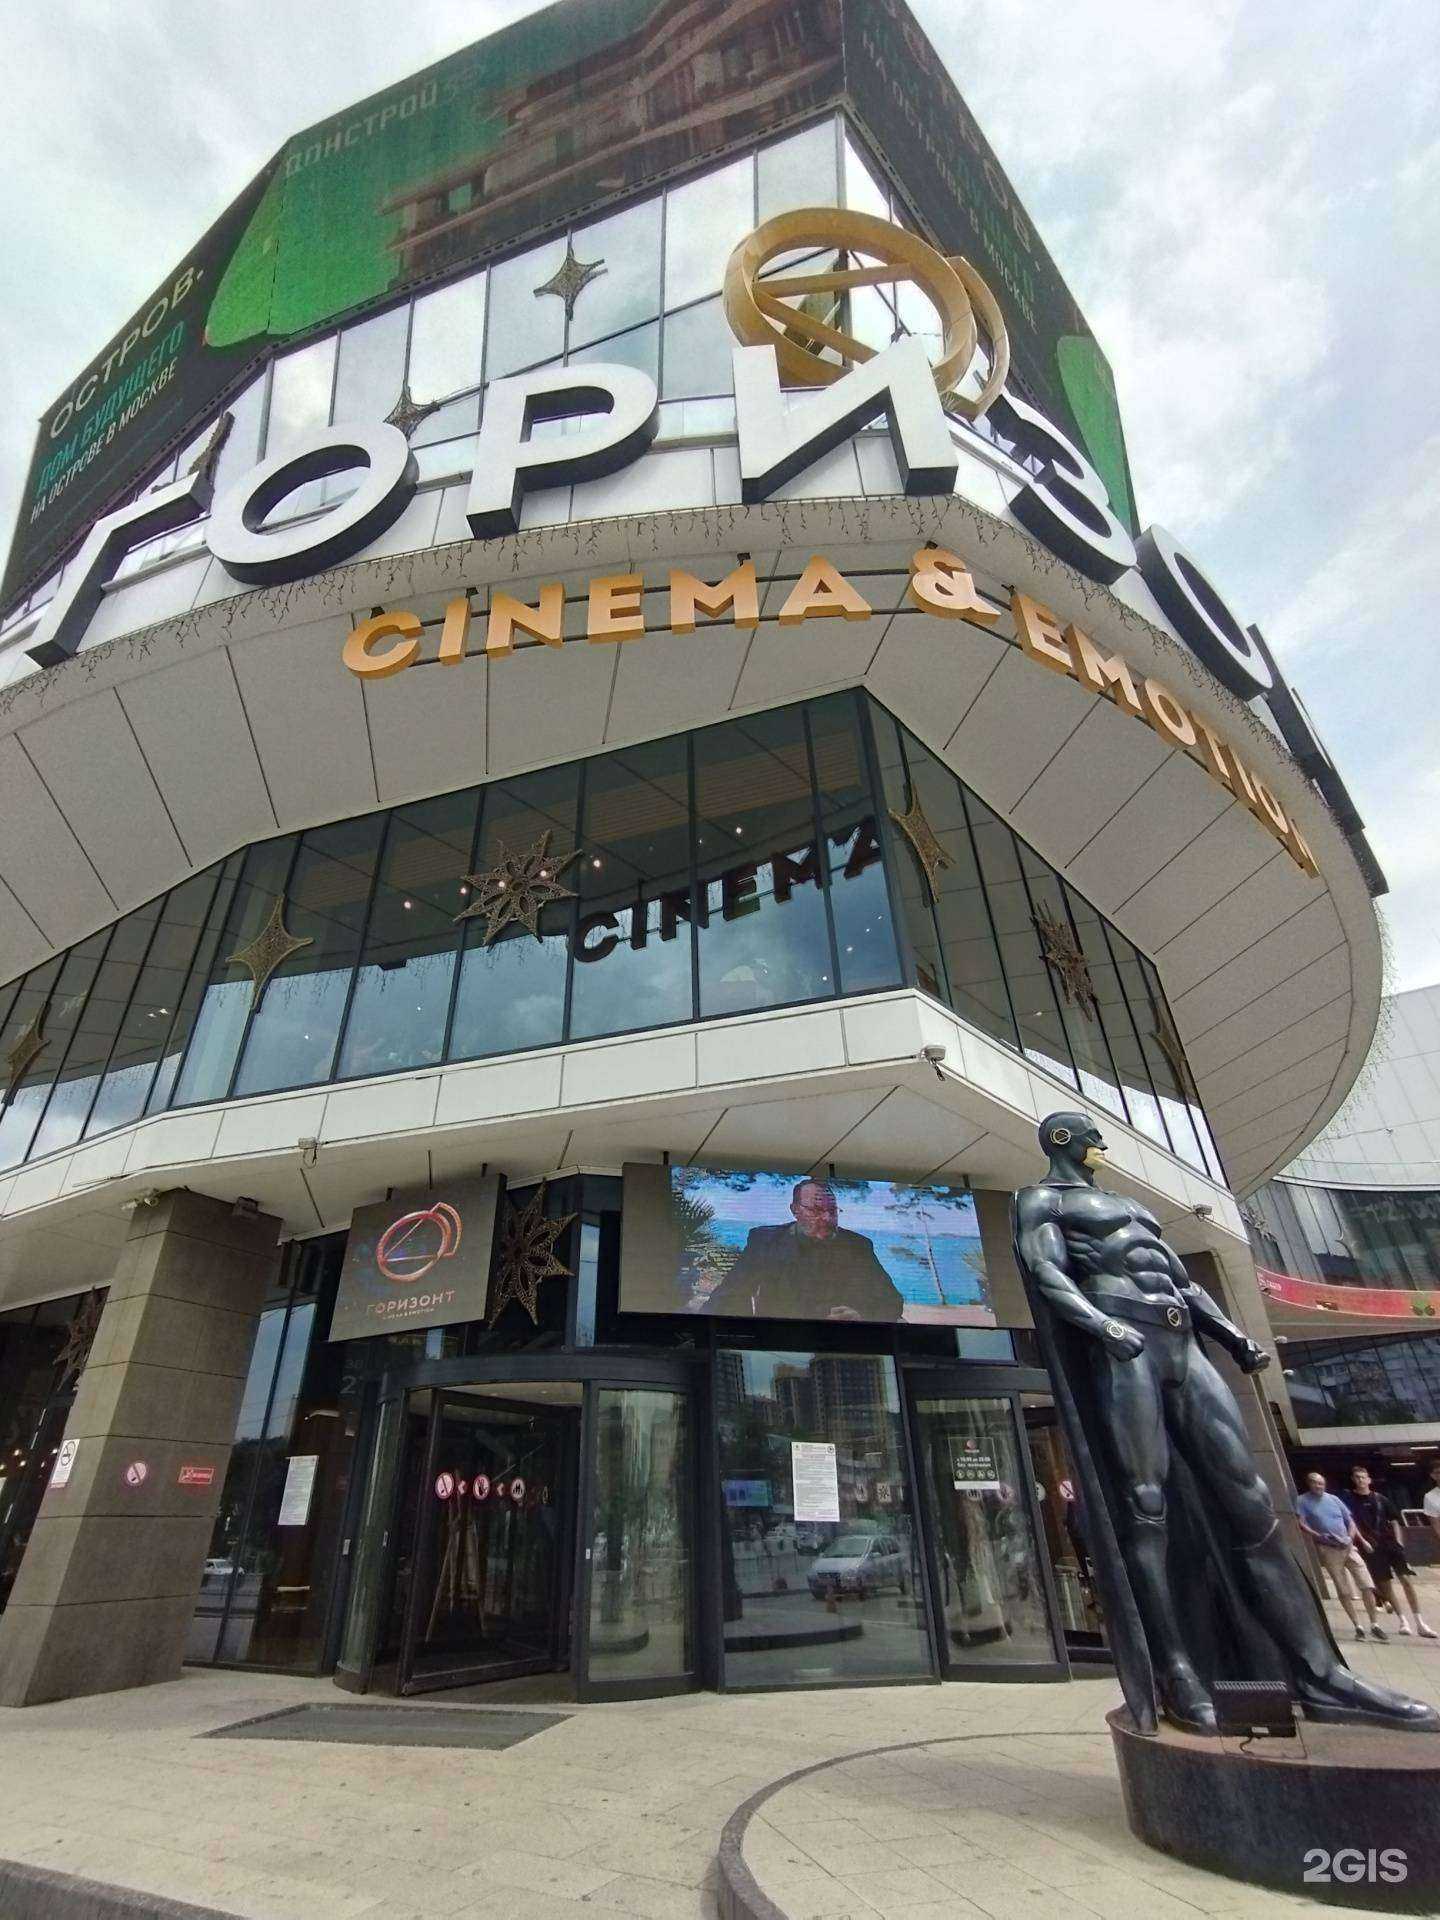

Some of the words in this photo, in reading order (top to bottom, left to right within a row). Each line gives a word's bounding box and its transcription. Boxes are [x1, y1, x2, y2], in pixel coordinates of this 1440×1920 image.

[50, 267, 204, 439] ОСТРОВ.
[80, 320, 185, 448] БУДУЩЕГО
[30, 496, 47, 524] НА
[48, 432, 104, 504] ОСТРОВЕ
[106, 421, 117, 446] В
[118, 356, 178, 432] МОСКВЕ
[25, 335, 1390, 894] ГОРИЗО
[341, 555, 872, 680] CINEMA
[907, 548, 1001, 628] &
[574, 816, 881, 963] CINEMA
[368, 1290, 456, 1316] ГОРИЗОНТ
